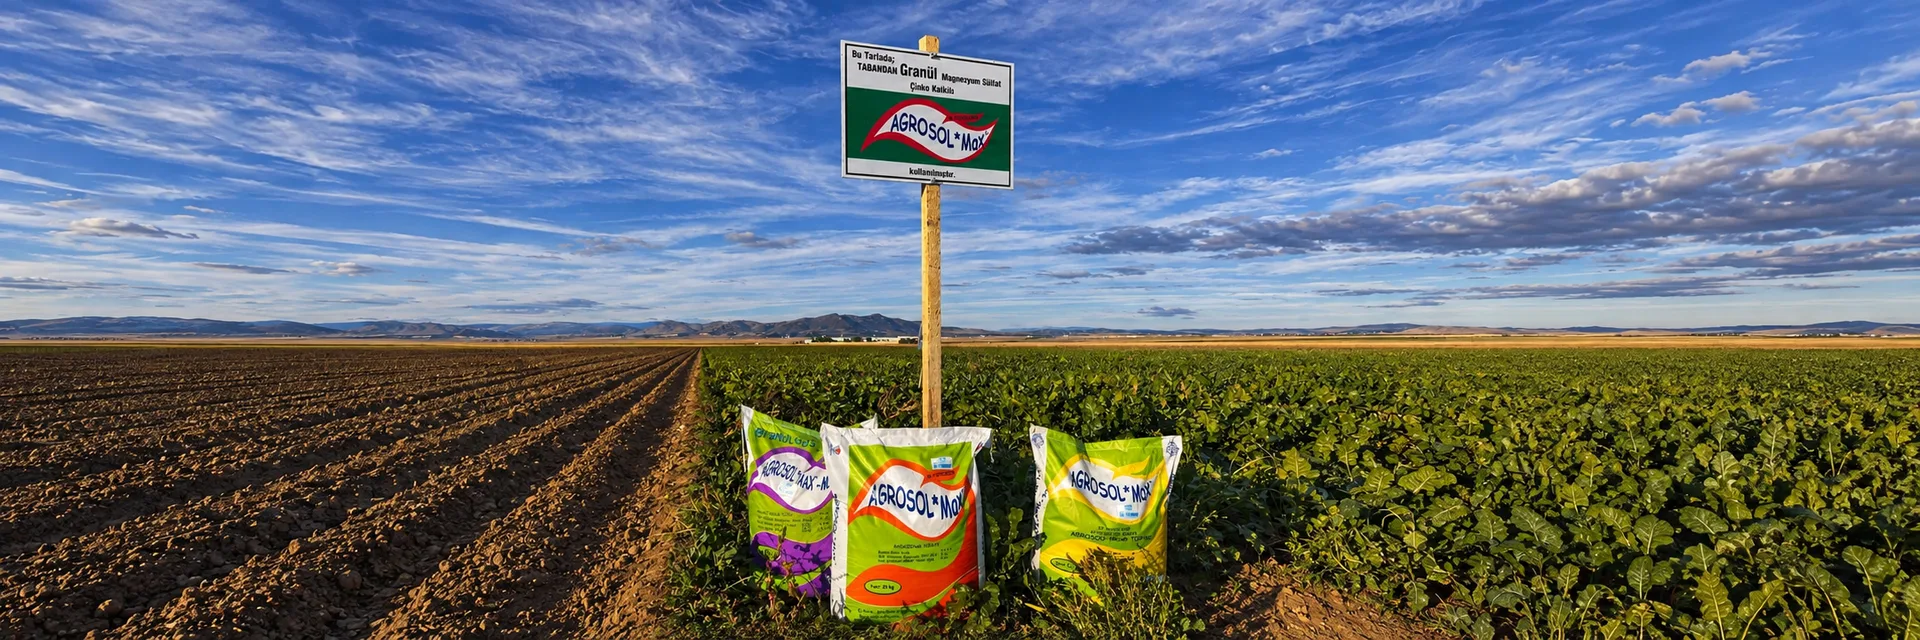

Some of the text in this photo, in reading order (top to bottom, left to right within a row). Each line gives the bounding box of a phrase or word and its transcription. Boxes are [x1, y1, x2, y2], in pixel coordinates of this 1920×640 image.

[852, 49, 895, 64] Bu Tarlada;
[857, 62, 898, 75] TABANDAN
[900, 63, 937, 80] Granül
[941, 73, 981, 85] Magnezyum
[910, 82, 930, 92] Çinko
